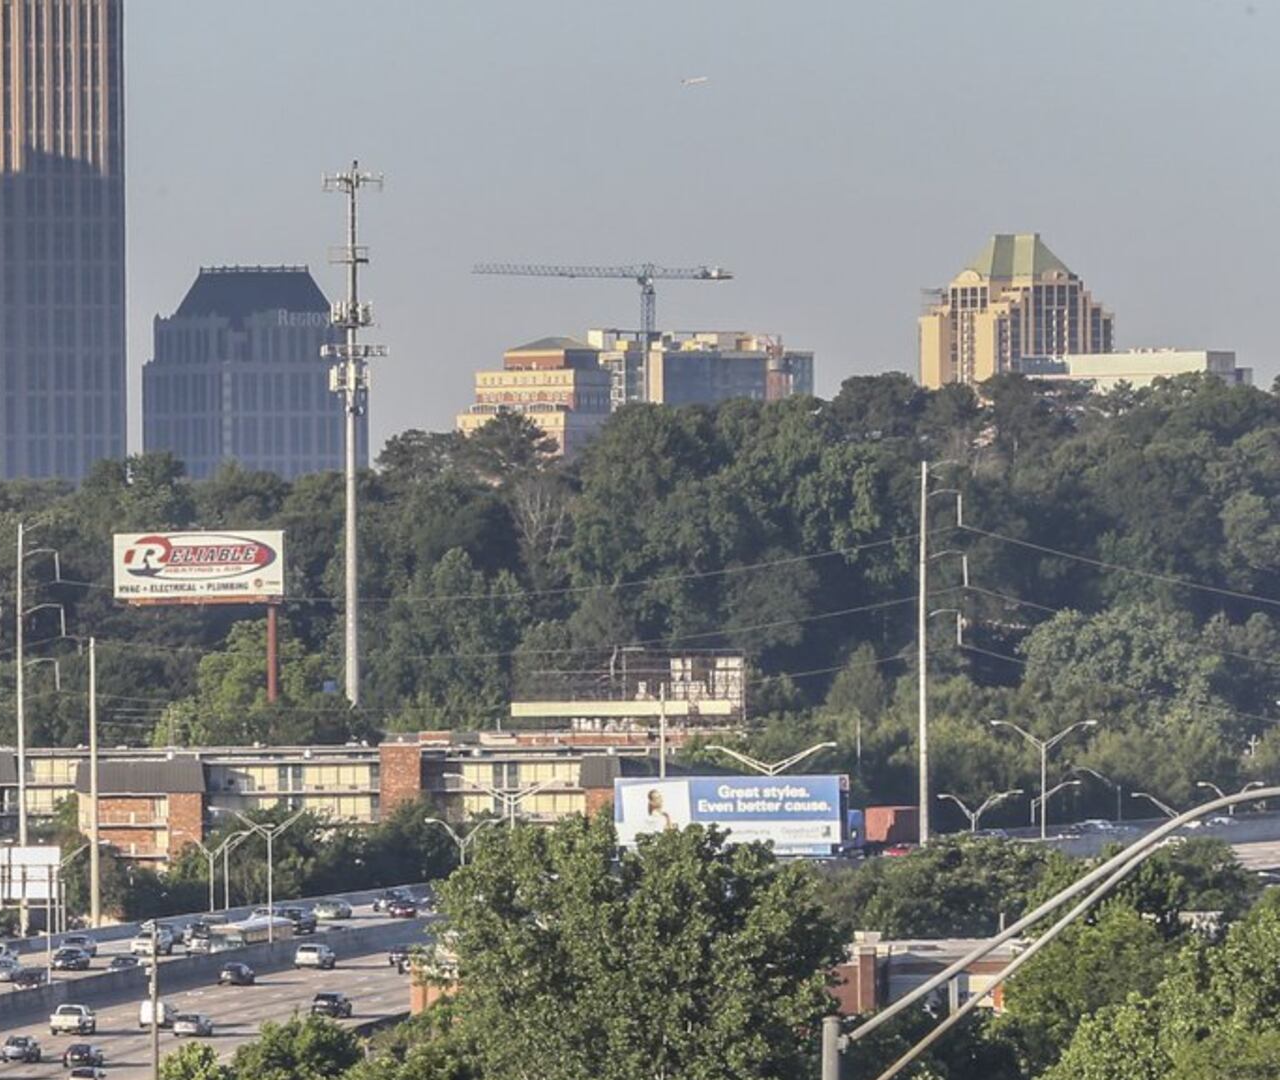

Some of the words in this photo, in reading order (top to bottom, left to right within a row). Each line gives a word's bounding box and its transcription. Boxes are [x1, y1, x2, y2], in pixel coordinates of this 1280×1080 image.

[150, 582, 196, 593] ELECTRICAL
[206, 581, 249, 592] PLUMBING
[718, 784, 760, 799] Great
[763, 784, 810, 800] styles.
[698, 801, 734, 813] Even
[739, 800, 781, 813] better
[785, 801, 832, 813] cause.
